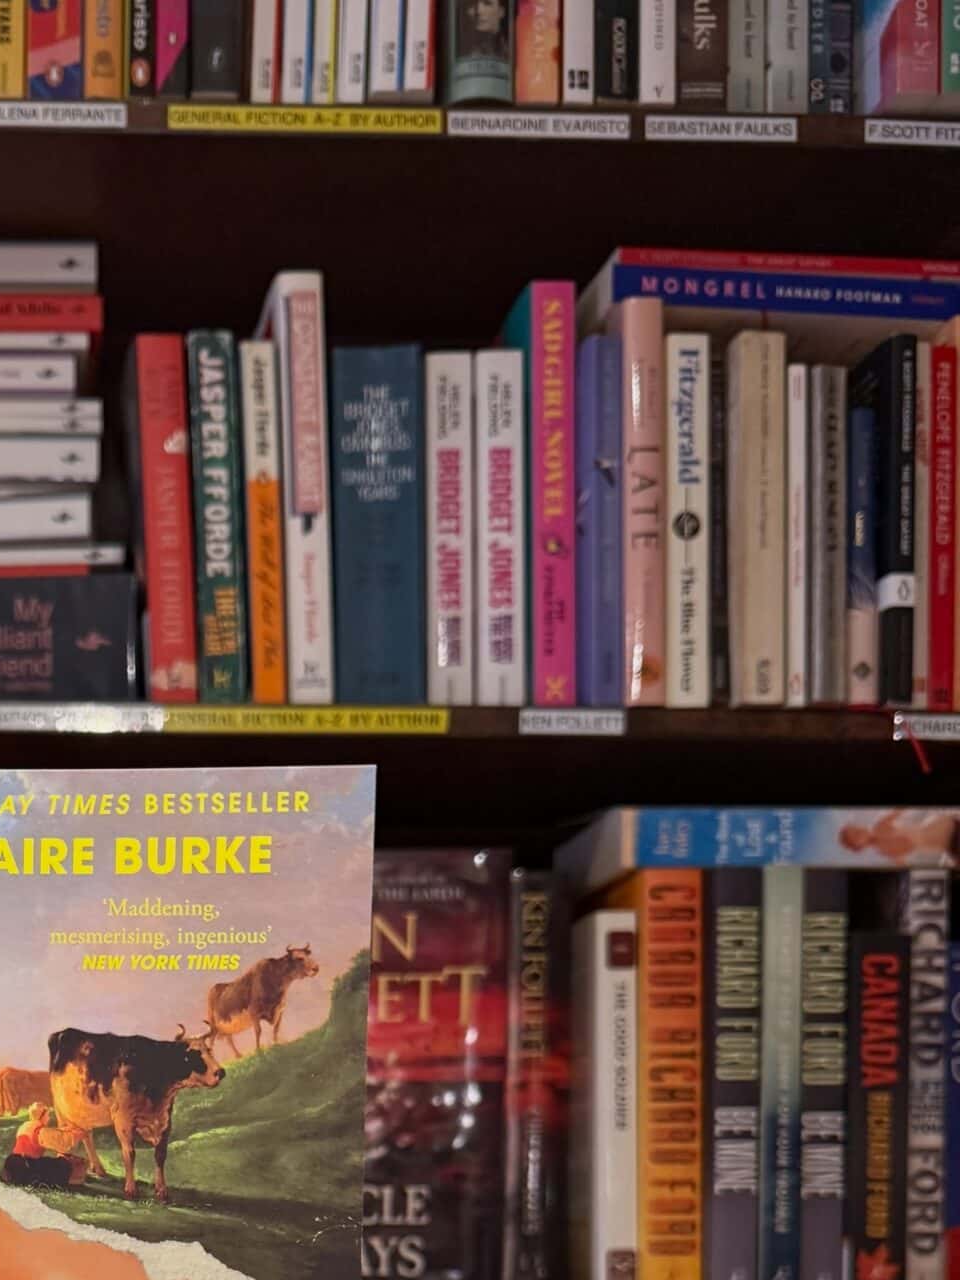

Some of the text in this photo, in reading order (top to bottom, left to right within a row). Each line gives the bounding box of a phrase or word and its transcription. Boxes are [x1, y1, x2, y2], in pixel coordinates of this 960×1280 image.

[42, 107, 123, 122] FERRANTE
[172, 108, 437, 128] GENERAL FICTION BY AUTHOR
[451, 116, 630, 134] BERNARDINE EVARISTO
[647, 121, 793, 138] SEBASTIAN FAULKS
[641, 276, 902, 304] MONGREL FOOTMAN
[250, 357, 269, 406] Jasper
[542, 298, 564, 518] SAD GIRL NOVEL
[674, 347, 701, 485] Fitzgerald
[198, 347, 233, 578] JASPER FFORDE
[438, 448, 461, 536] BRIDGET
[935, 361, 952, 546] PENELOPE FITZGERALD
[489, 446, 513, 610] BRIDGET JONES
[627, 445, 661, 551] LATE
[14, 599, 54, 625] My
[439, 543, 462, 610] JONES
[47, 793, 132, 816] TIMES
[143, 790, 311, 816] BESTSELLER
[114, 836, 273, 874] BURKE
[49, 926, 171, 948] mesmerising,
[82, 954, 240, 971] NEW YORK TIMES
[910, 874, 945, 1067] RICHARD
[648, 884, 697, 1257] CANADA RICHARD FORD
[714, 906, 759, 1195] RICHARD FORD BE MINE
[802, 912, 847, 1199] RICHARD FORD BE MINE
[860, 953, 900, 1238] CANADA RICHARD FORD
[910, 1146, 940, 1258] FORD
